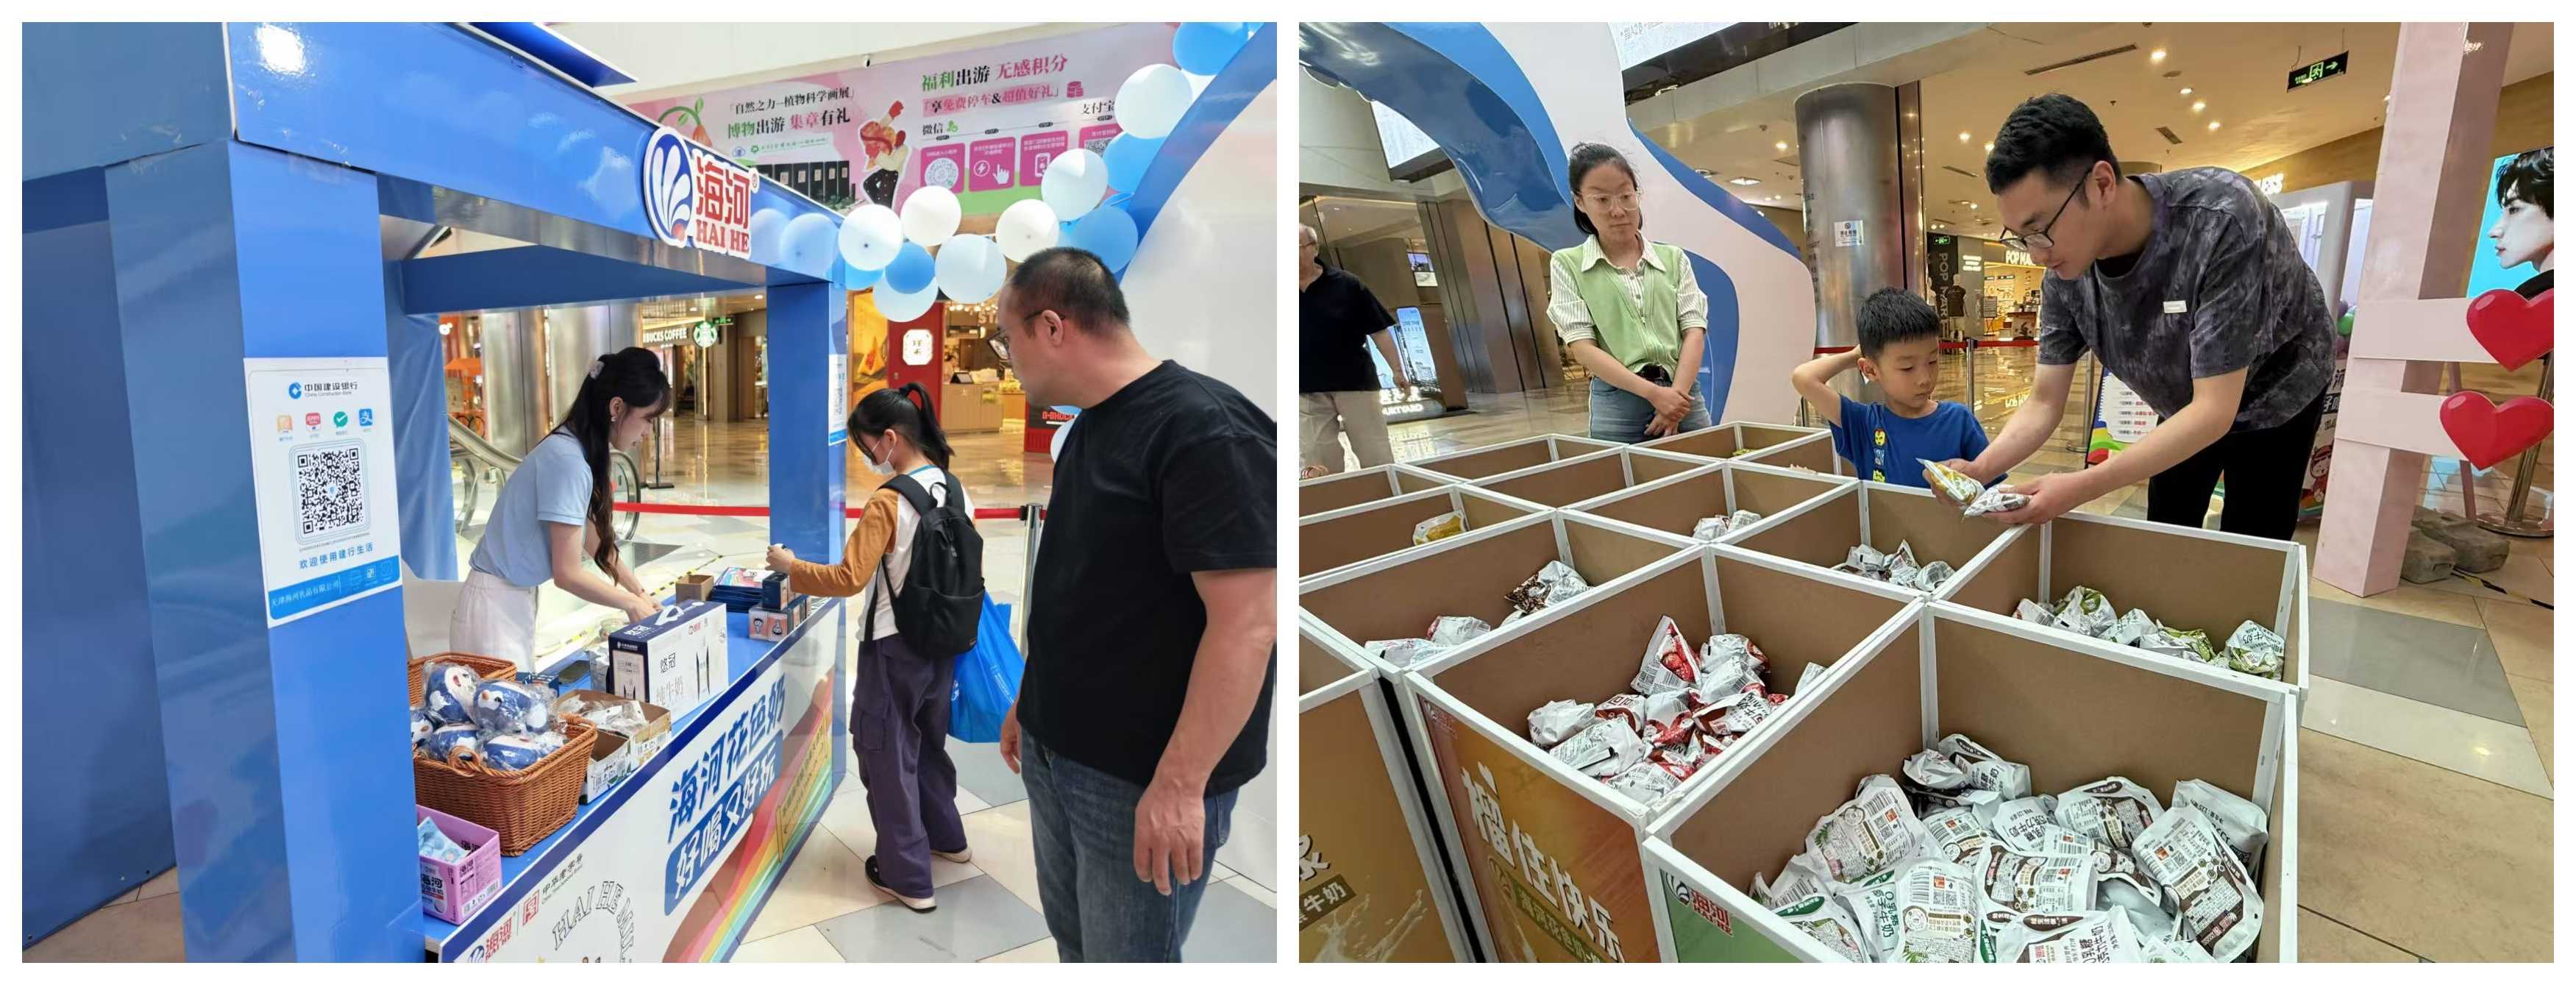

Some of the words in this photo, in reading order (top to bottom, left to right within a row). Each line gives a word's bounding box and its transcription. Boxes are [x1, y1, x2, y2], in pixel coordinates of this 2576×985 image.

[922, 65, 990, 91] 福利出游
[996, 54, 1067, 80] 无感积分
[728, 117, 785, 138] 博物出游
[790, 107, 850, 129] 集章有礼
[922, 123, 943, 135] 微信
[696, 155, 750, 230] 海河
[696, 218, 725, 248] HAI
[730, 228, 750, 253] HE
[1939, 252, 1949, 282] POP
[2006, 250, 2018, 265] POP
[664, 327, 687, 340] COFFEE
[304, 381, 357, 392] 中国建设银行
[299, 541, 374, 569] 欢迎使用建行生活
[660, 652, 676, 674] 悠冠
[668, 672, 786, 844] 海河花色奶
[675, 741, 777, 900] 好喝又好玩
[542, 853, 583, 895] 中华老字号
[552, 885, 595, 951] HAI
[596, 881, 624, 915] HE
[1690, 888, 1731, 928] 海河
[485, 917, 513, 954] 海河
